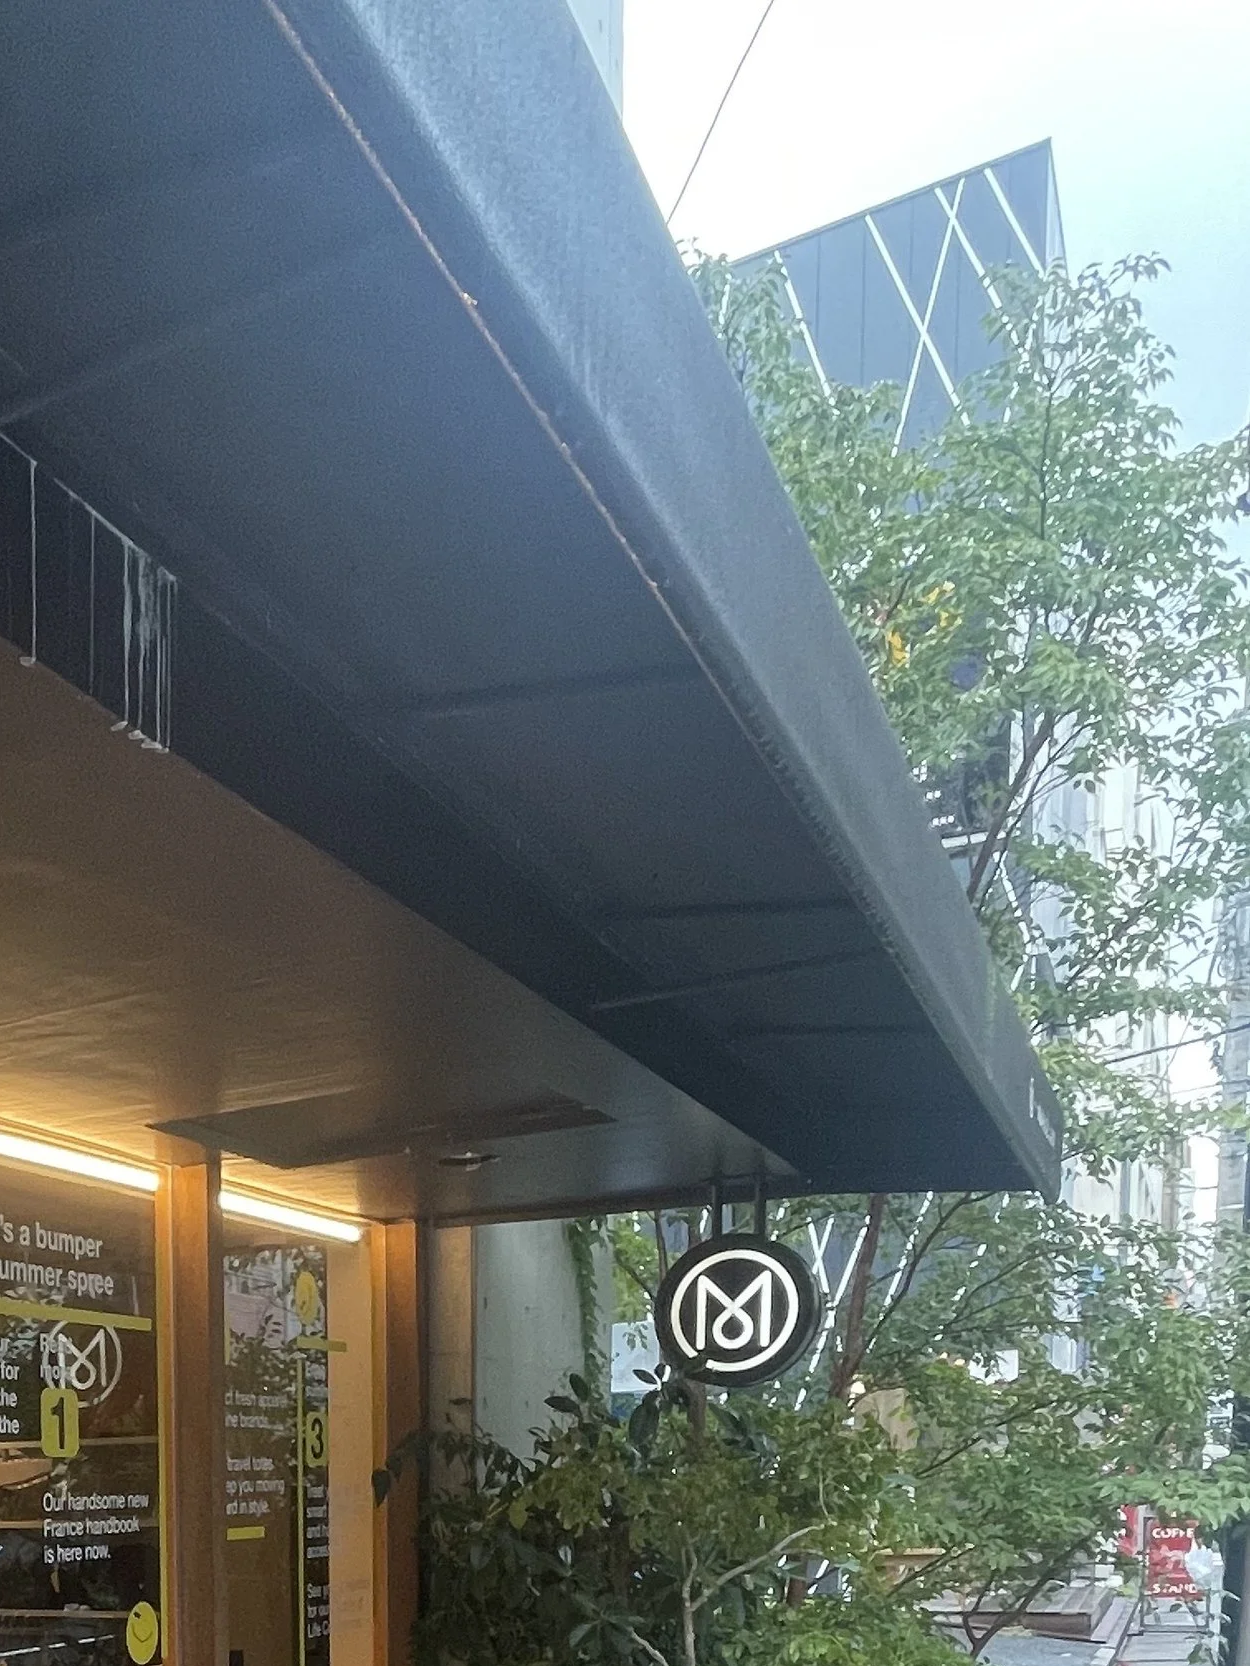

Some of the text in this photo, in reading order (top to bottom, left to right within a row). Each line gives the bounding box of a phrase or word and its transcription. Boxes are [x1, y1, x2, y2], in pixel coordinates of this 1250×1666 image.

[20, 1225, 30, 1246] a
[36, 1222, 102, 1260] bumper
[68, 1270, 114, 1298] spree
[0, 1360, 20, 1380] for
[51, 1397, 65, 1450] 1
[311, 1418, 324, 1459] 3
[43, 1491, 149, 1512] Our handsome new
[43, 1516, 140, 1538] France handbook
[1152, 1527, 1195, 1539] COFFE
[44, 1543, 111, 1564] is here now.
